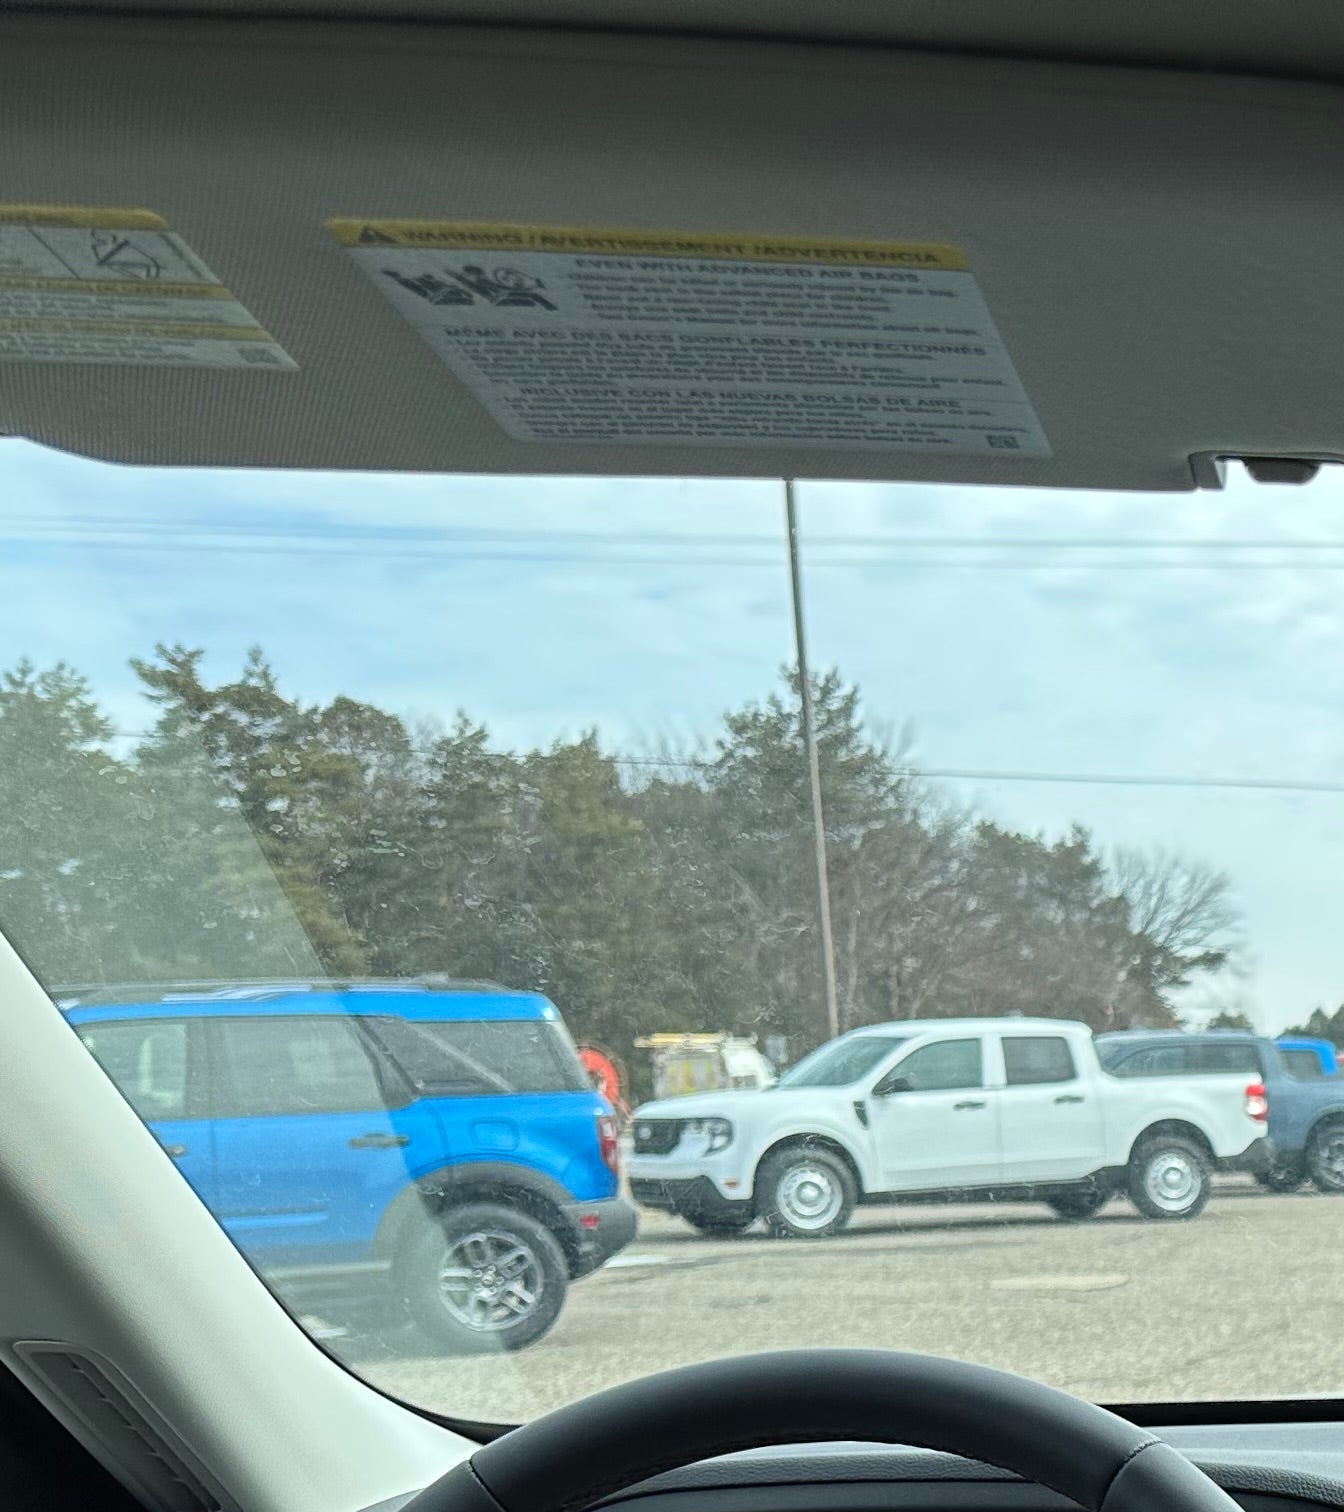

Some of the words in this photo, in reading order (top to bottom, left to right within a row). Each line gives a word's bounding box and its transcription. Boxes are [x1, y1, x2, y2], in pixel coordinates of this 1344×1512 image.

[402, 229, 523, 245] WARNING
[576, 258, 633, 271] EVEN
[640, 260, 692, 273] WITH
[698, 263, 813, 279] ADVANCED
[820, 269, 852, 280] AIR
[860, 271, 920, 284] BAGS
[628, 389, 670, 400] CON
